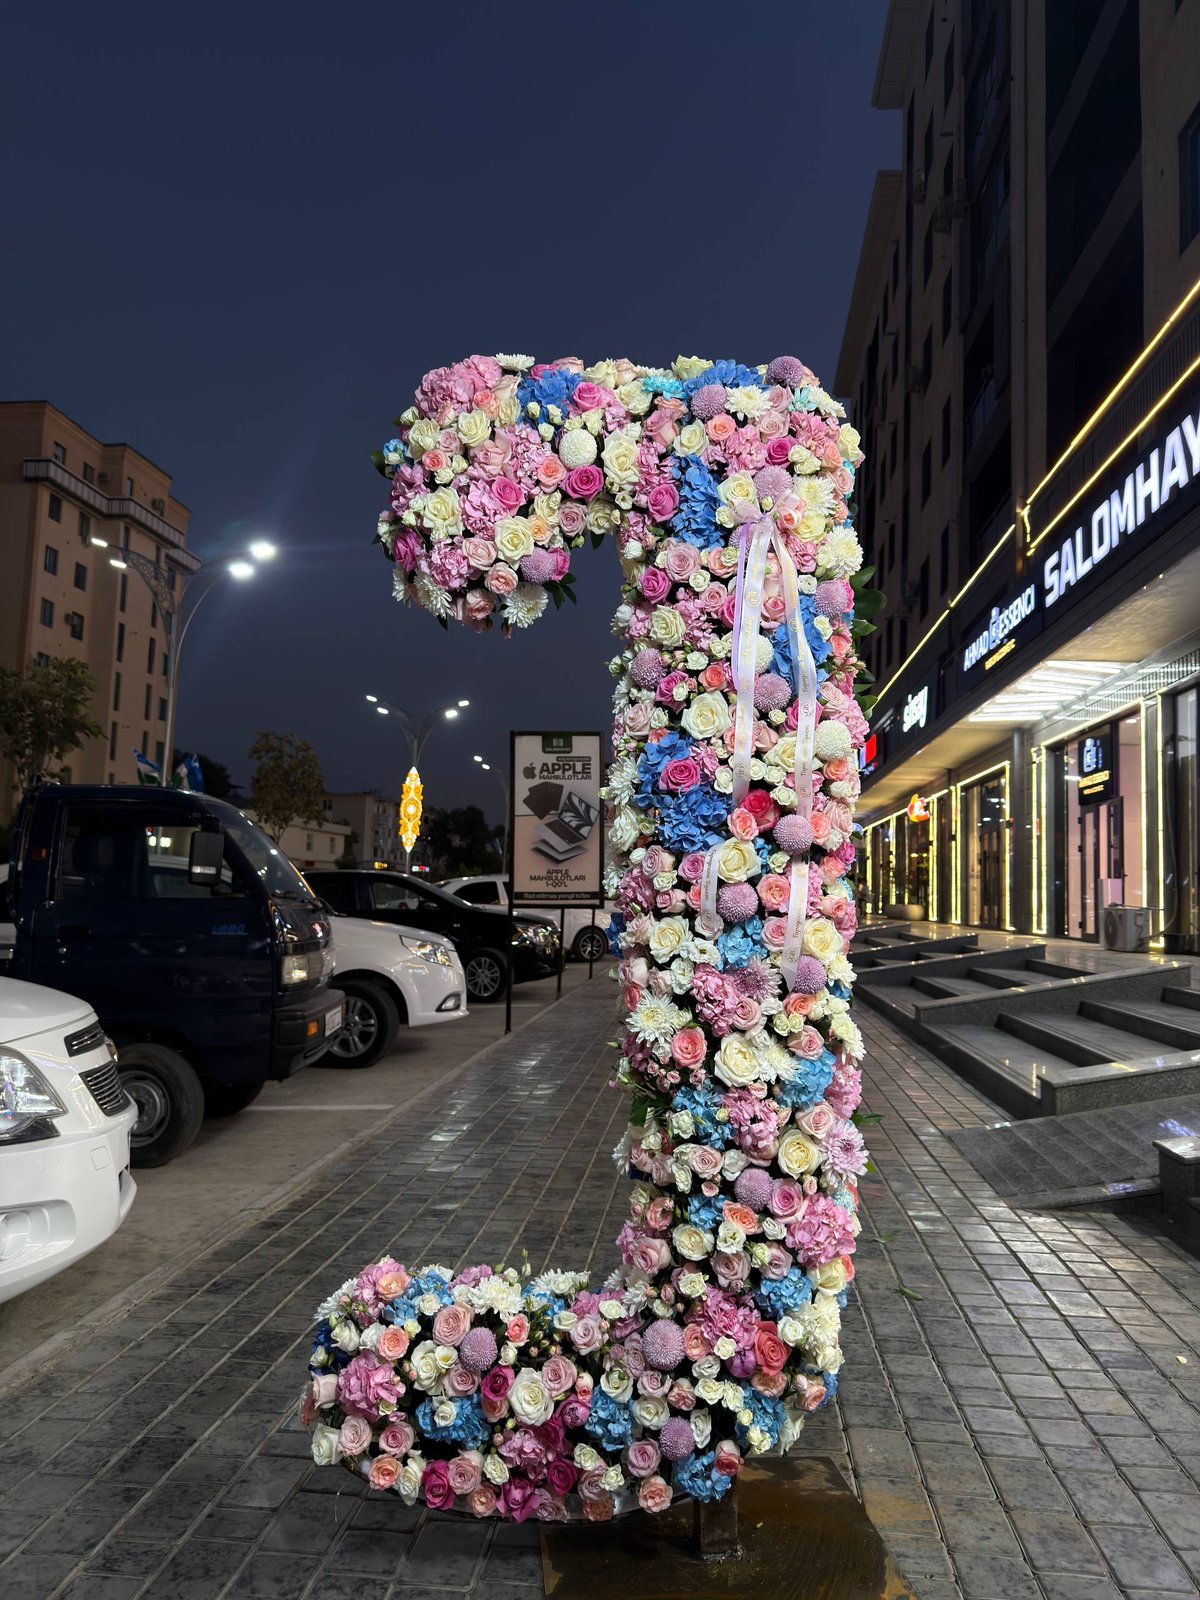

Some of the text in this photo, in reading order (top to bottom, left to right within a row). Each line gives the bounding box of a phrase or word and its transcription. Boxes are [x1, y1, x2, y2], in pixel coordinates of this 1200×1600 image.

[1044, 411, 1200, 608] SALOMHAY
[963, 630, 990, 672] AHMAD
[540, 763, 592, 774] APPLE
